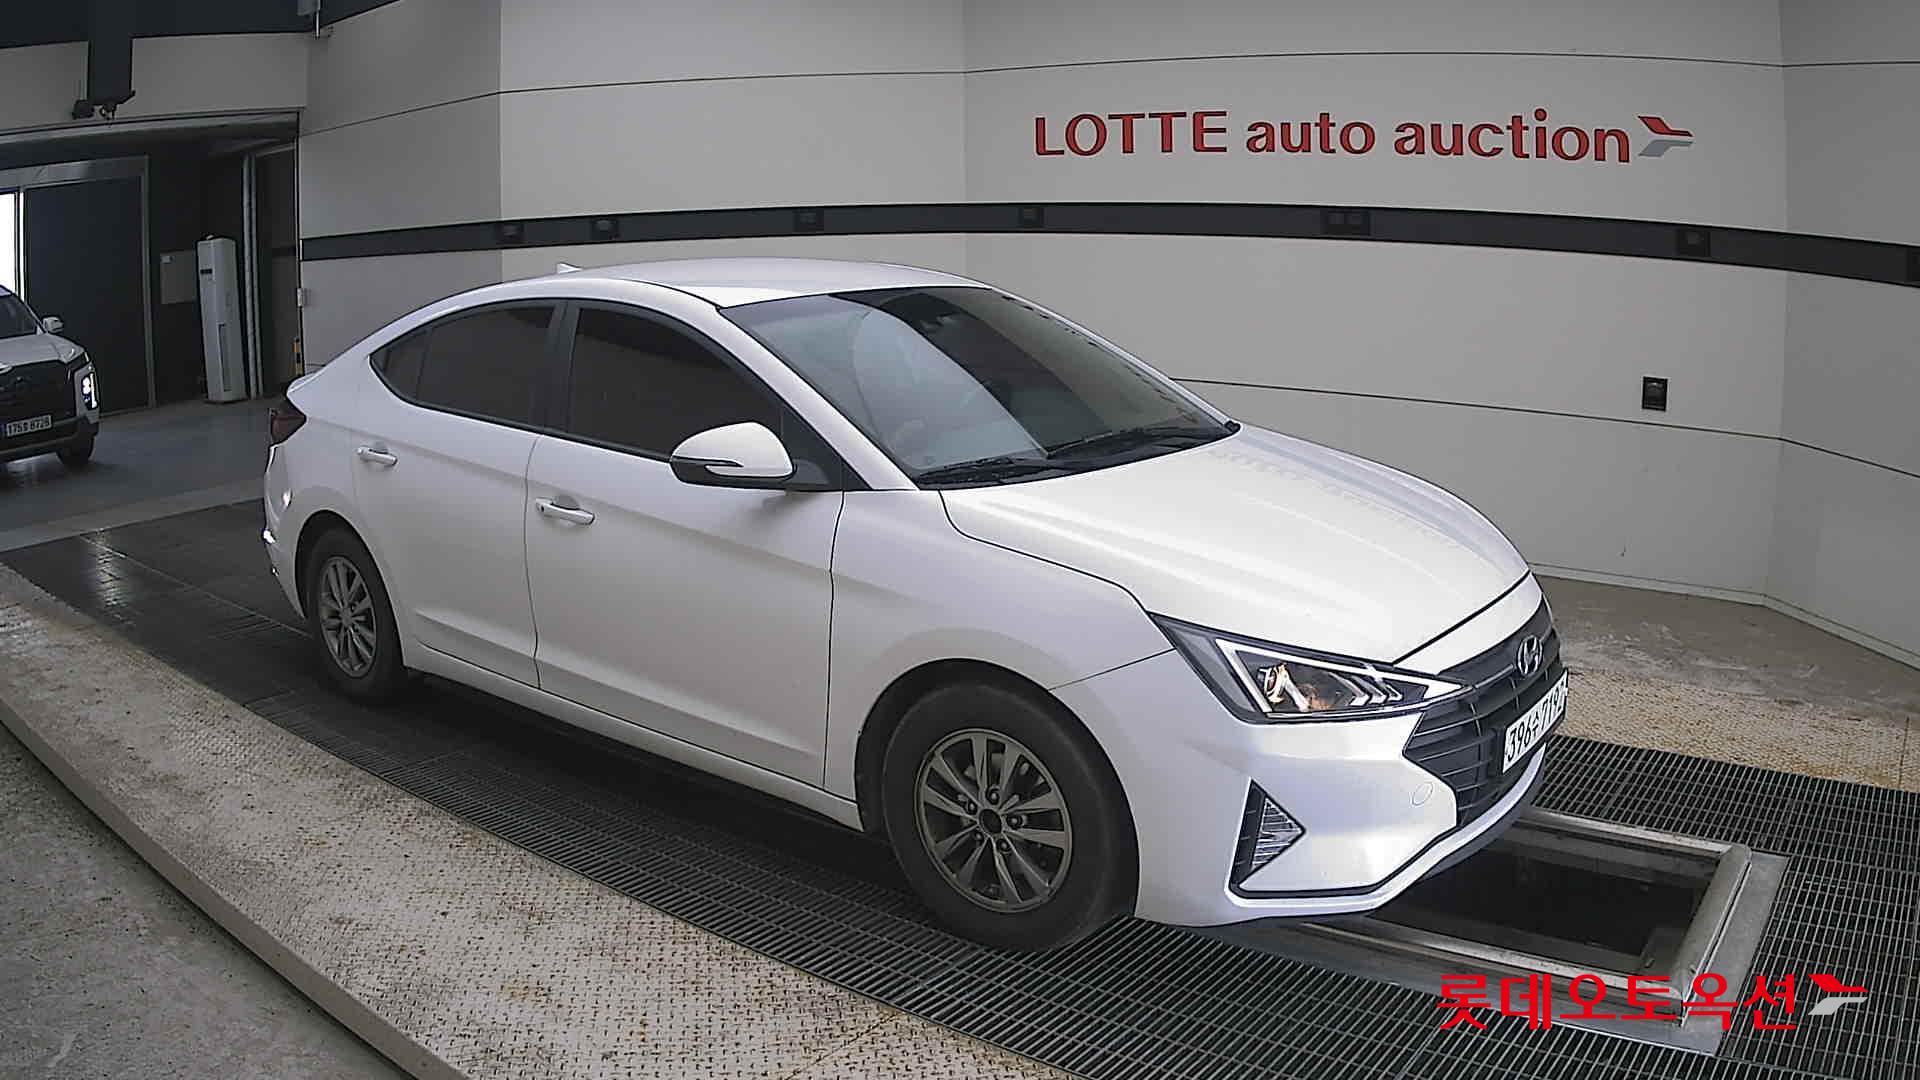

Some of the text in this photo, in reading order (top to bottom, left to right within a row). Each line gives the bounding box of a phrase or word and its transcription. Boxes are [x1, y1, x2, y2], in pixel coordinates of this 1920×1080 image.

[1035, 108, 1631, 163] LOTTE auto auction
